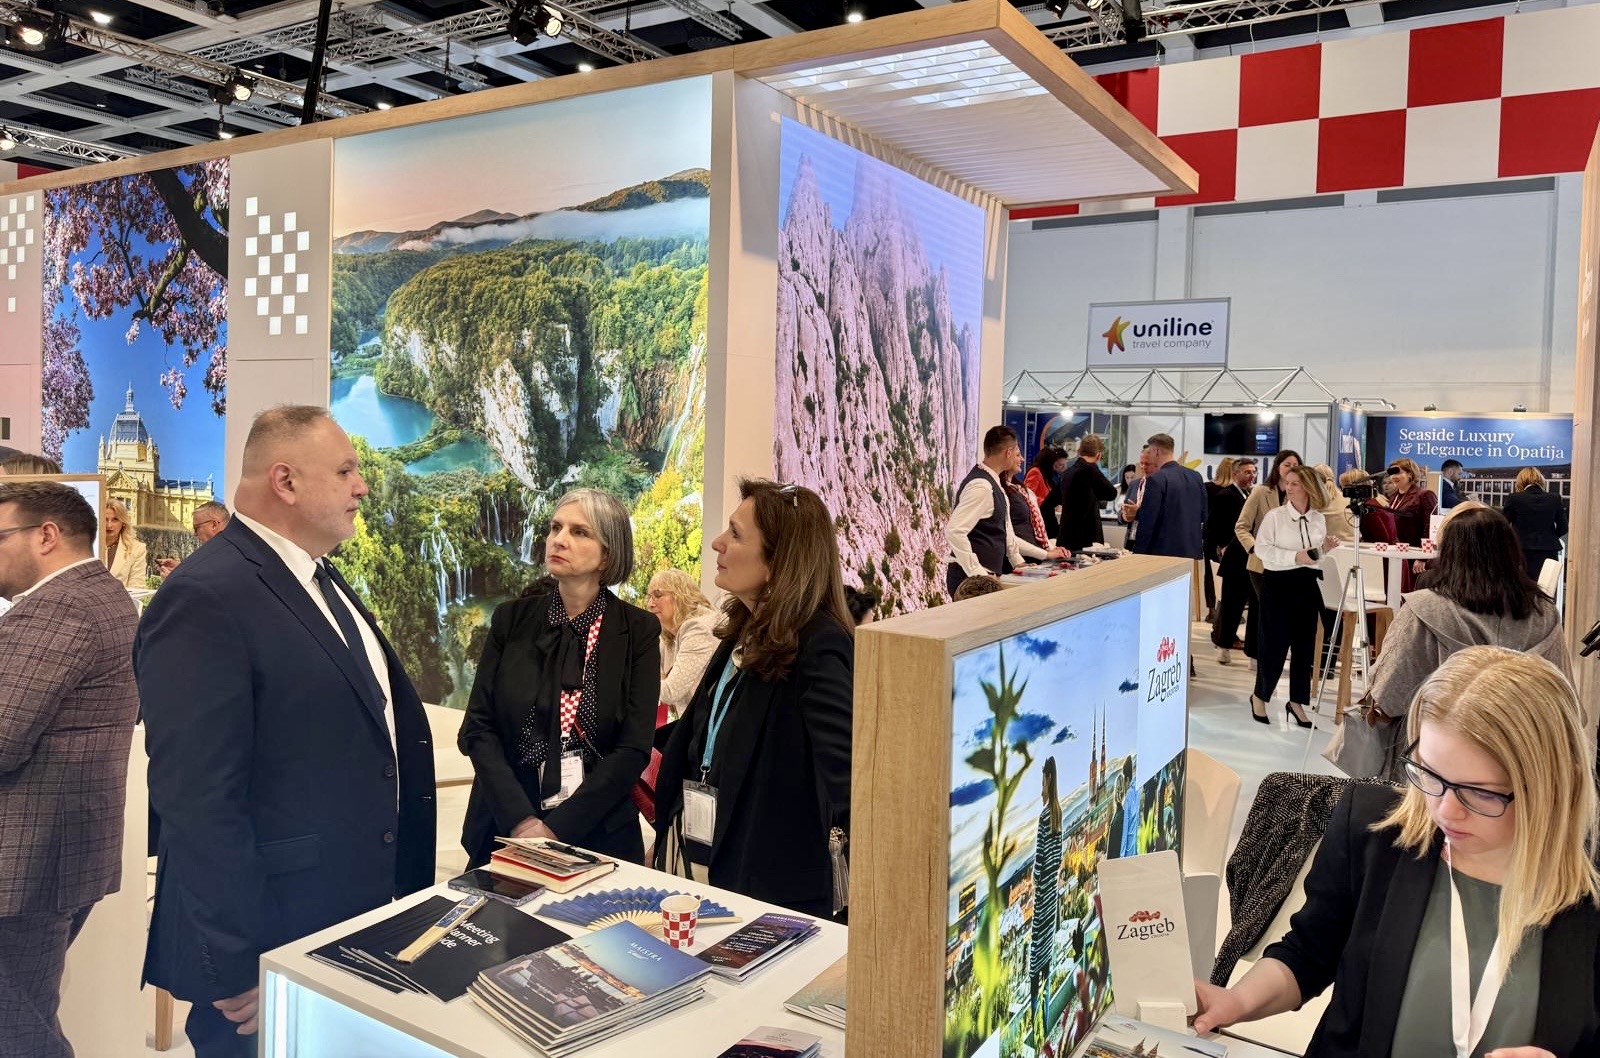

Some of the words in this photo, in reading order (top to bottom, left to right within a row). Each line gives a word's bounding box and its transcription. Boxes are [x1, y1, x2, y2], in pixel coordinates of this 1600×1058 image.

[1133, 317, 1213, 337] uniline
[1133, 340, 1160, 349] travel
[1163, 339, 1212, 350] company
[1399, 428, 1455, 442] Seaside
[1459, 429, 1515, 445] Luxury
[1399, 442, 1413, 455] &
[1417, 443, 1483, 458] Elegance
[1487, 444, 1502, 457] in
[1507, 445, 1565, 461] Opatija
[1147, 652, 1182, 703] Zagreb
[1117, 918, 1175, 941] Zagreb
